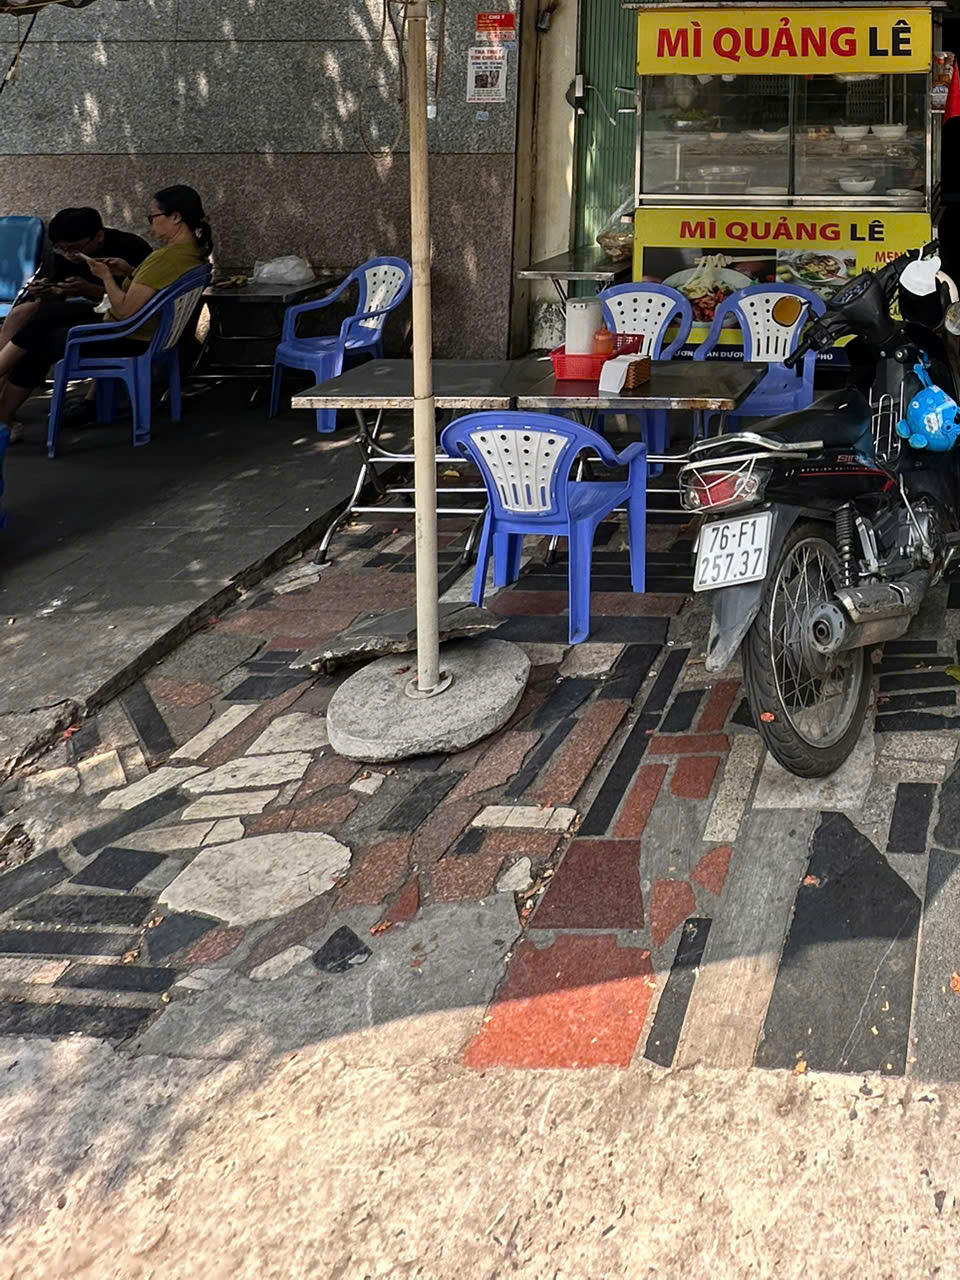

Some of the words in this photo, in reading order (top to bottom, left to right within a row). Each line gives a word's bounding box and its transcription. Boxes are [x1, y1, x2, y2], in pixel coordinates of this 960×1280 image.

[656, 20, 703, 59] MÌ
[712, 16, 857, 63] QUẢNG
[868, 19, 913, 57] LÊ
[680, 217, 716, 241] MÌ
[725, 216, 841, 242] QUẢNG
[850, 219, 885, 242] LÊ
[874, 250, 909, 264] MEN
[699, 548, 763, 585] 257.37
